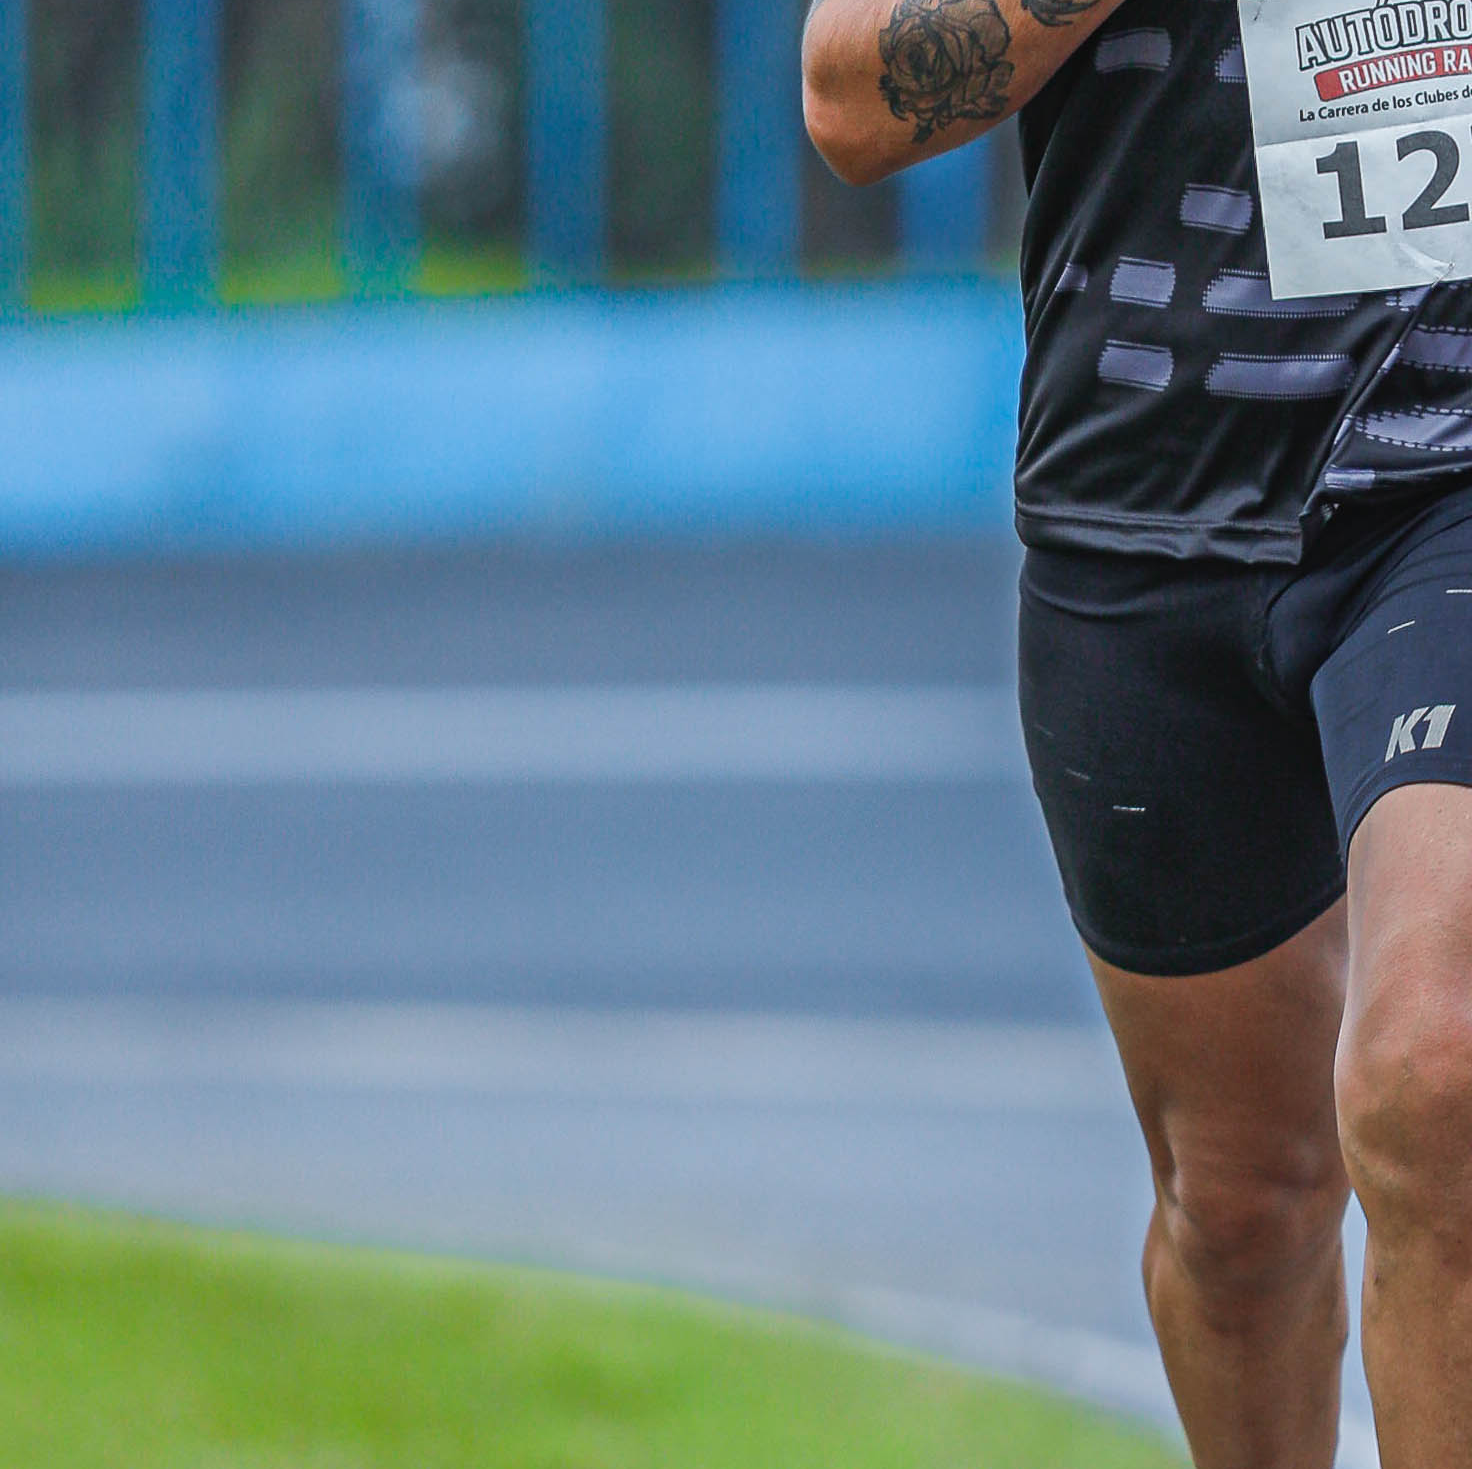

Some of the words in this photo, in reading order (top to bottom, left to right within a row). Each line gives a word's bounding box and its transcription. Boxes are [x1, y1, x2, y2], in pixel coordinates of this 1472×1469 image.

[1337, 50, 1437, 93] RUNNING
[1299, 109, 1315, 122] La
[1318, 102, 1369, 119] Carrera
[1372, 97, 1390, 112] de
[1392, 93, 1412, 108] los
[1415, 86, 1459, 106] Clubes
[1384, 704, 1457, 764] K1
